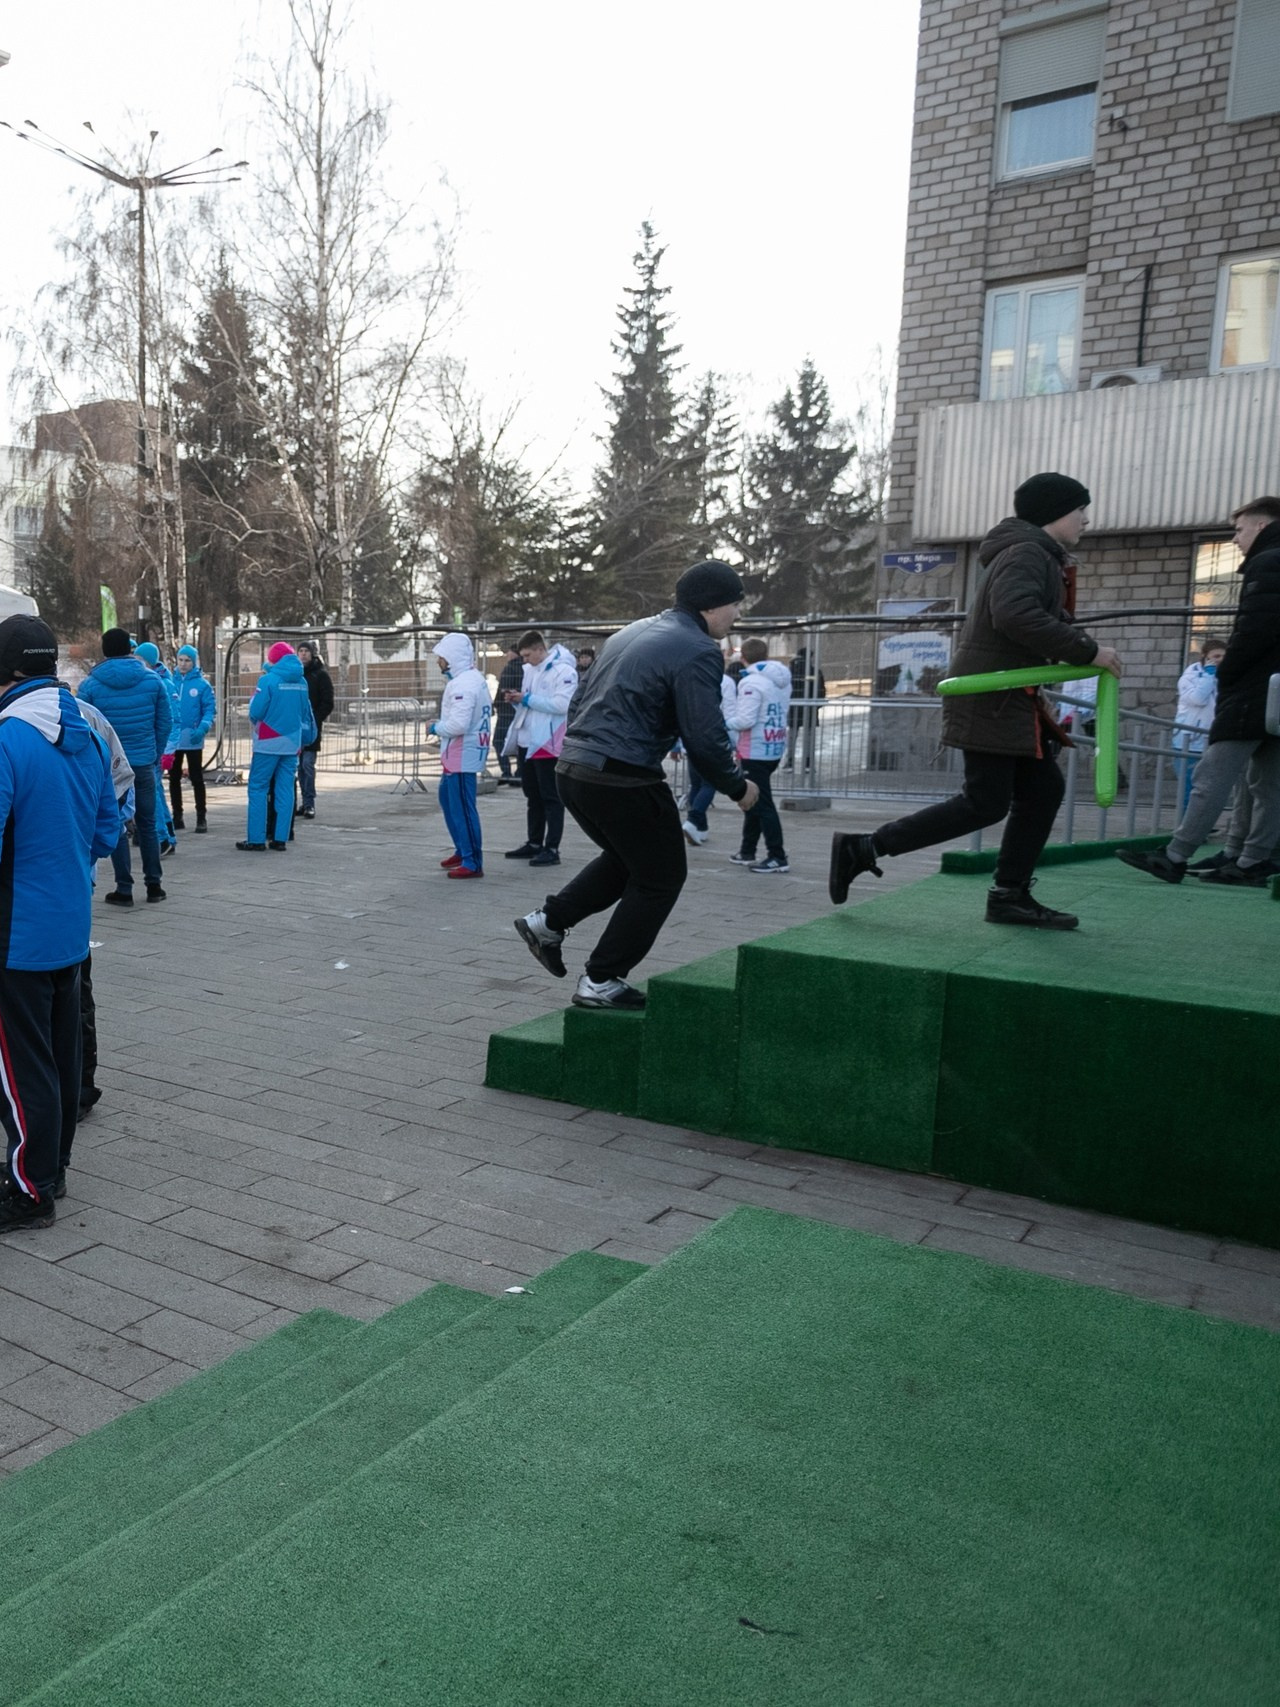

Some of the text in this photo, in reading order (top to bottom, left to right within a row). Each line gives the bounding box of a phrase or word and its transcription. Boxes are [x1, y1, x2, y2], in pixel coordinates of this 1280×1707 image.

[897, 554, 941, 564] пр. Мира
[914, 563, 922, 573] 3
